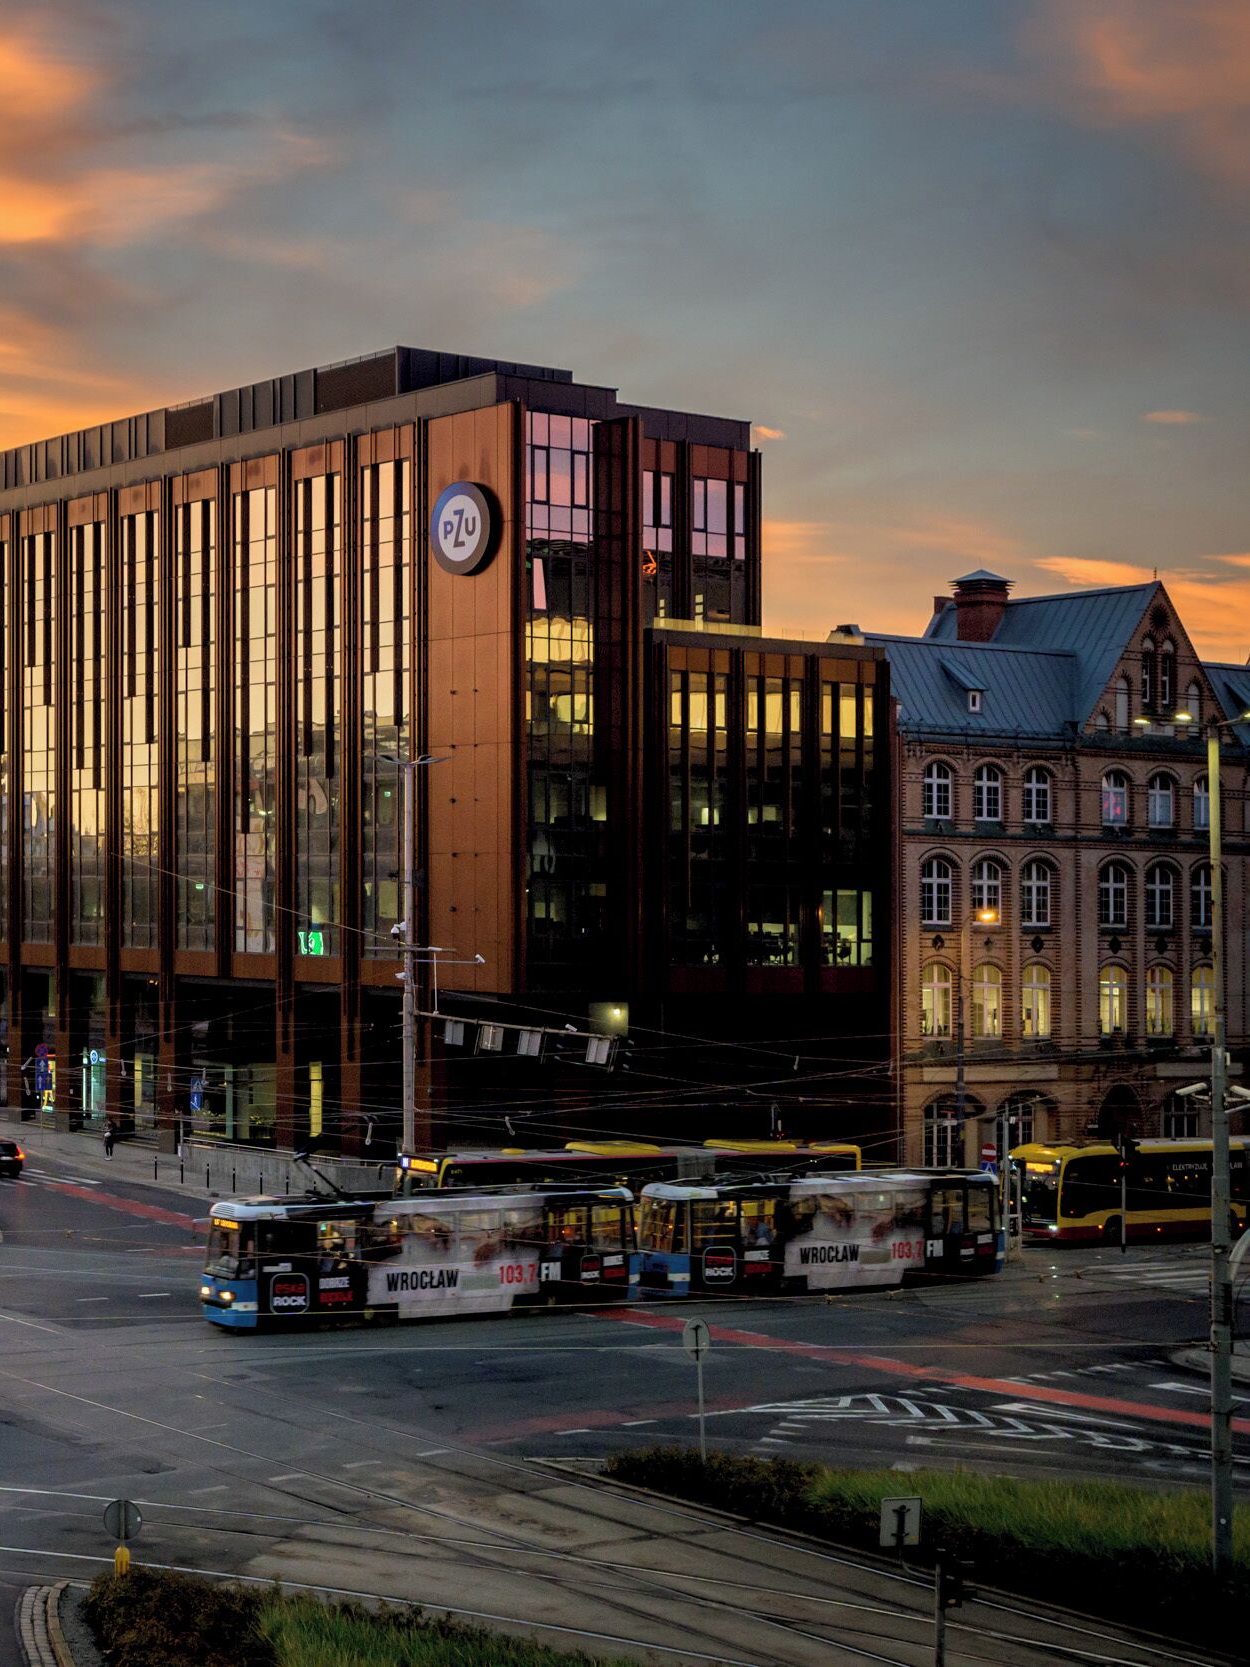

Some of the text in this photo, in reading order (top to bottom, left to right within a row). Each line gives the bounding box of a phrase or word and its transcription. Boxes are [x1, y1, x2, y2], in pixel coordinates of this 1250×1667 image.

[443, 508, 476, 548] PZU
[800, 1244, 859, 1264] WROCŁAW
[926, 1239, 944, 1258] FM
[386, 1268, 460, 1292] WROCŁAW
[541, 1261, 562, 1282] FM
[273, 1295, 307, 1306] ROCK
